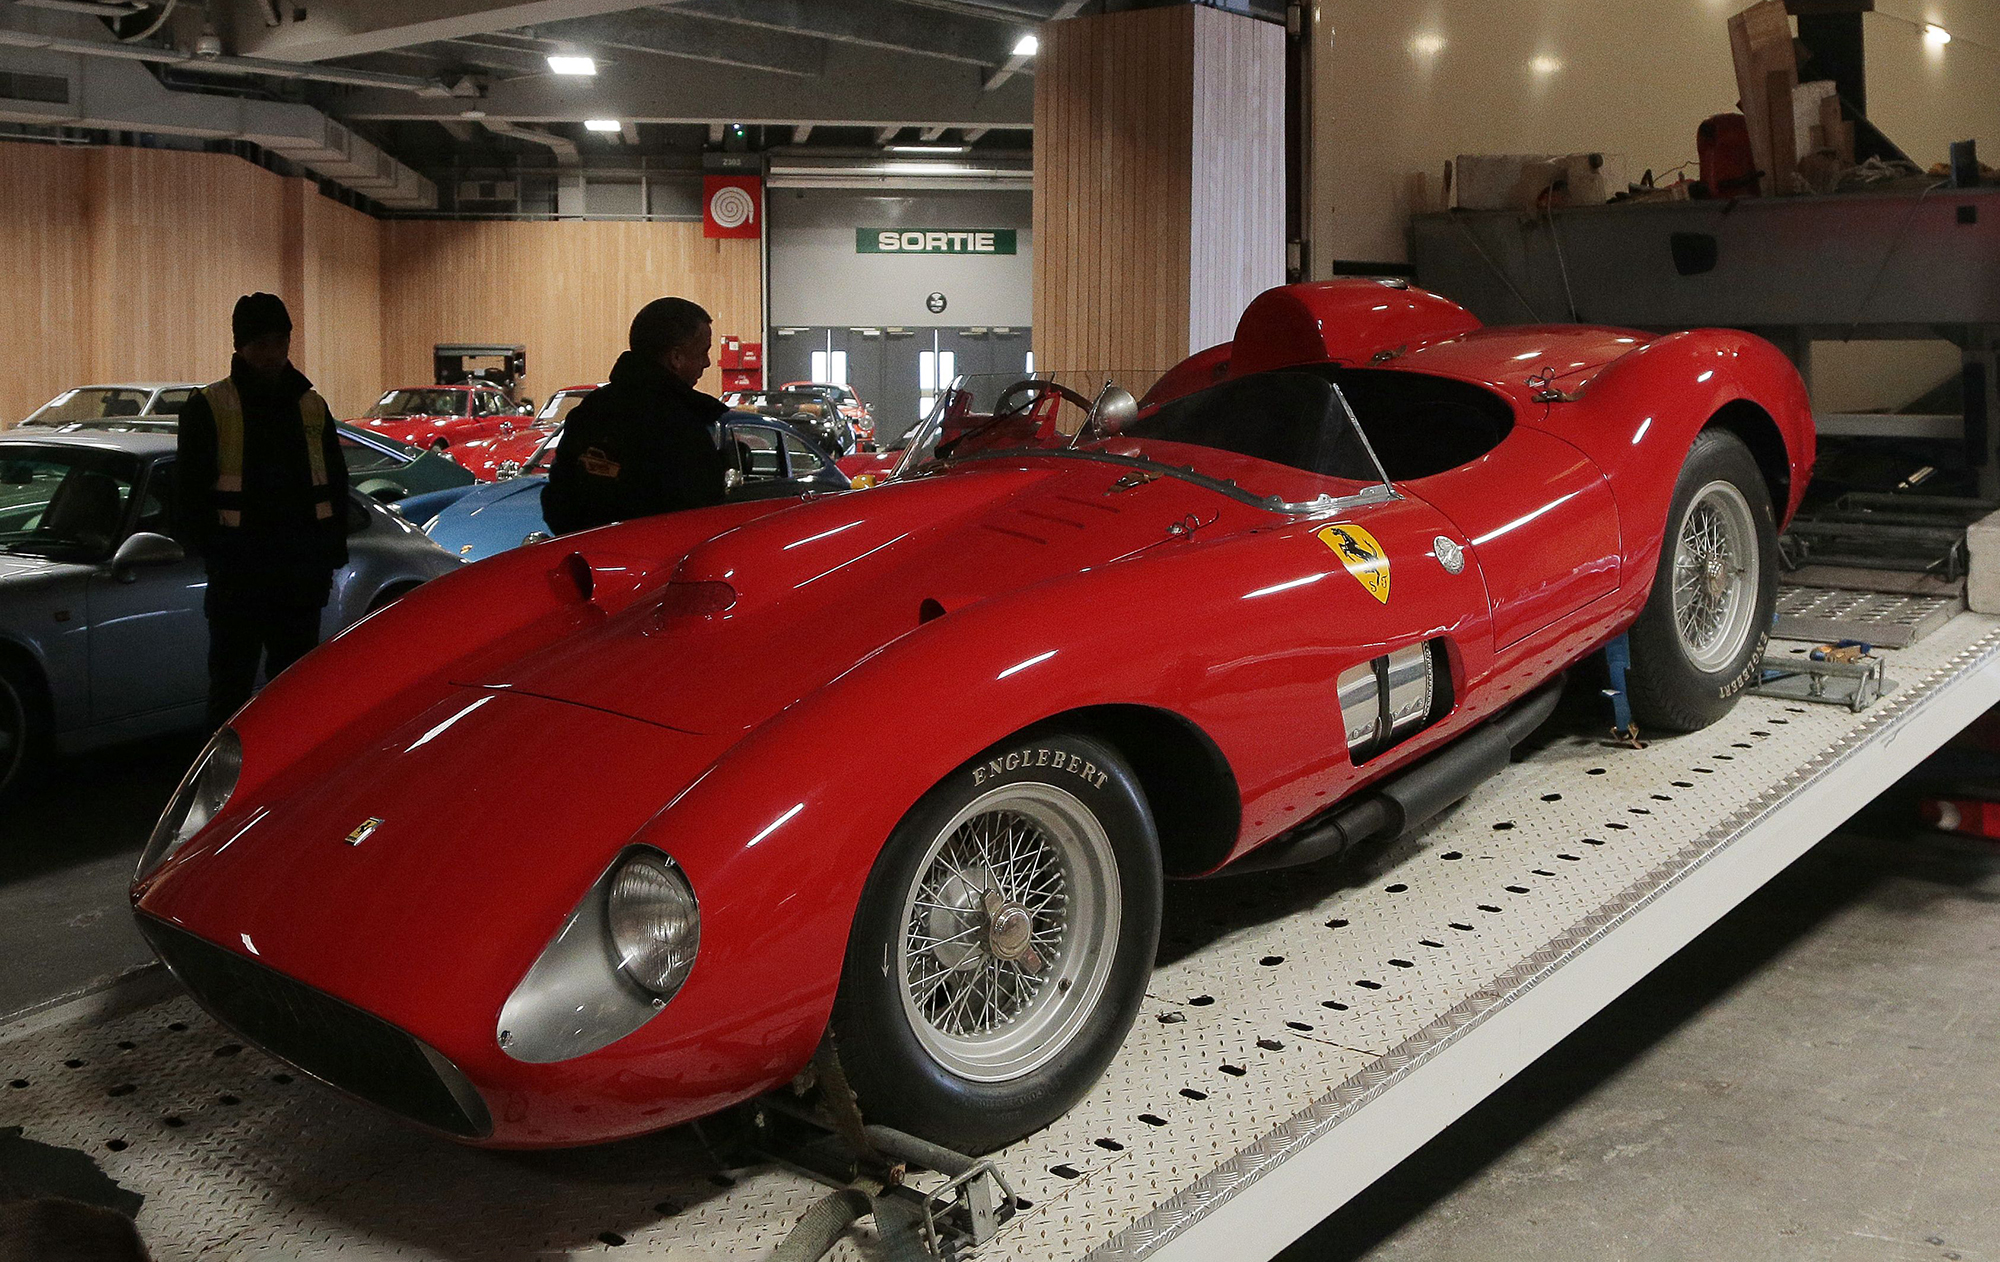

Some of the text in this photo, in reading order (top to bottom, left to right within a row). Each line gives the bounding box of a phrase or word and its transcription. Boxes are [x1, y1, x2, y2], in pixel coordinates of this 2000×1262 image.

[878, 231, 995, 251] SORTIE
[1719, 631, 1768, 699] ENGLEBERT
[972, 749, 1109, 790] ENGLEBERT
